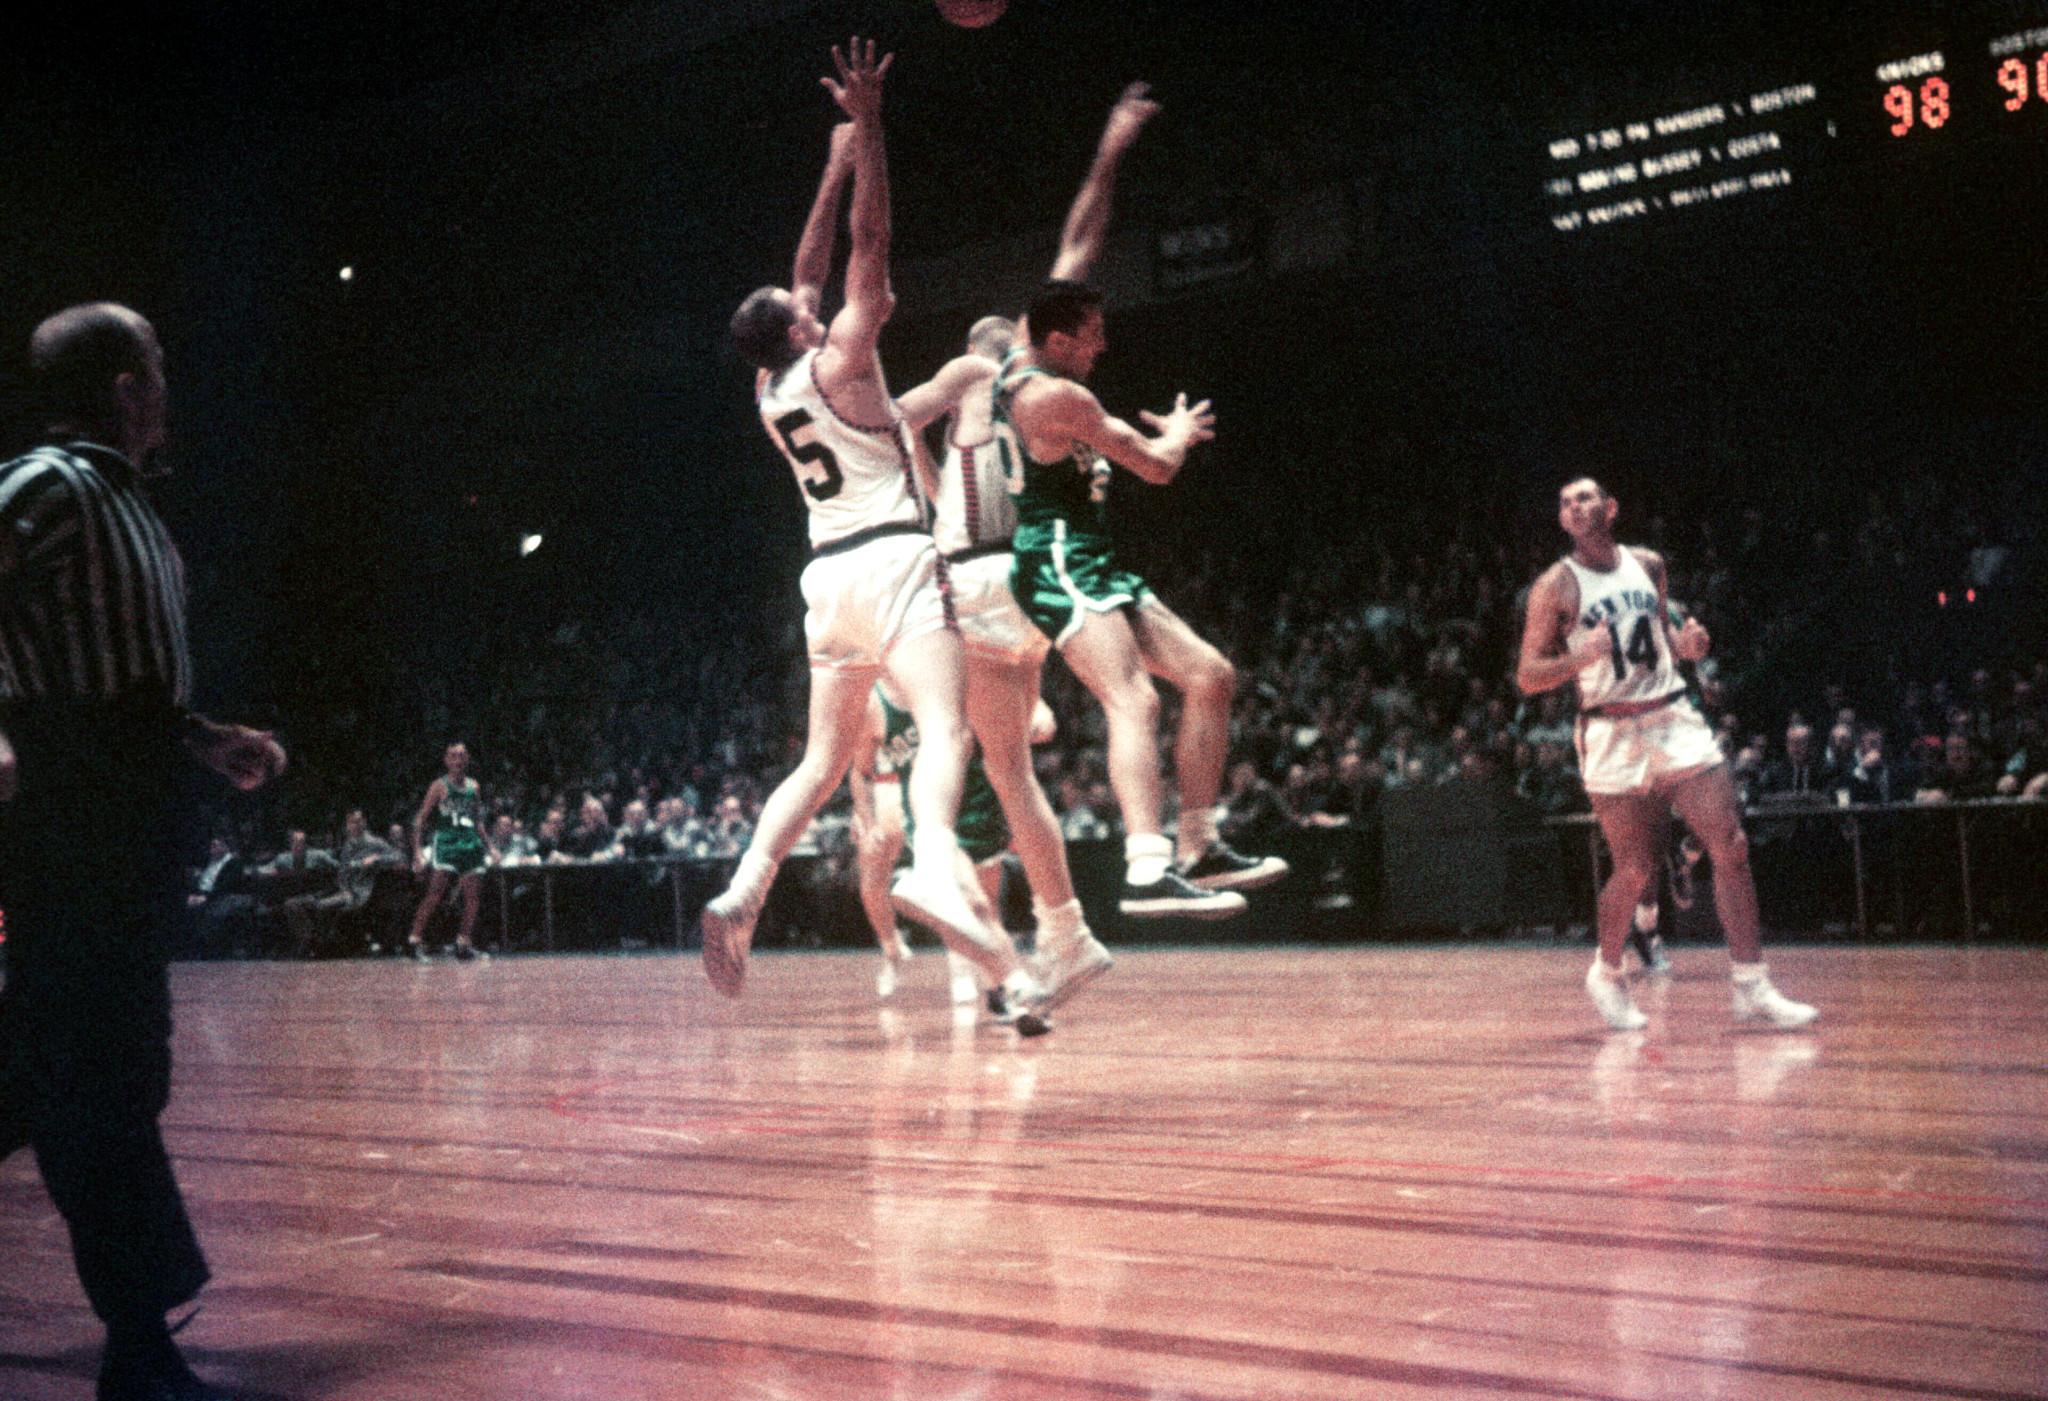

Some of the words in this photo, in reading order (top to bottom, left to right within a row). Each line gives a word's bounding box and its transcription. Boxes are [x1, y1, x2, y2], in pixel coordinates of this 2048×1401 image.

[1883, 75, 1951, 138] 98
[774, 407, 844, 502] 5
[1608, 614, 1659, 681] 14
